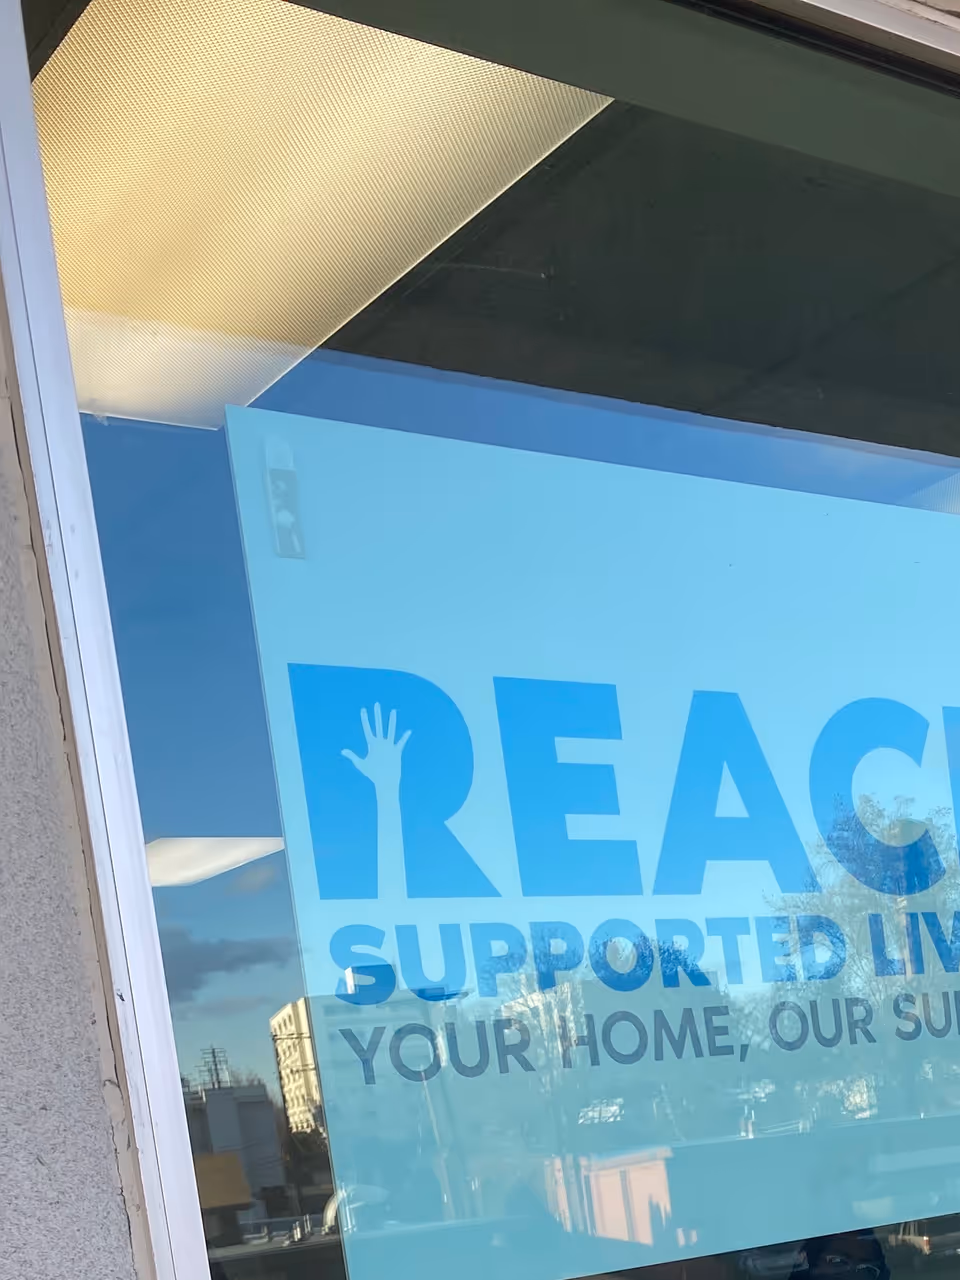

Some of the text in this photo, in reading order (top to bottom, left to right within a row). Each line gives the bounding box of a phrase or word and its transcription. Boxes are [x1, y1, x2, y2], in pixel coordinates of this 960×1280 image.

[329, 914, 846, 1006] SUPPORTED
[338, 1022, 536, 1086] YOUR
[560, 1005, 750, 1069] HOME,
[769, 996, 877, 1052] OUR
